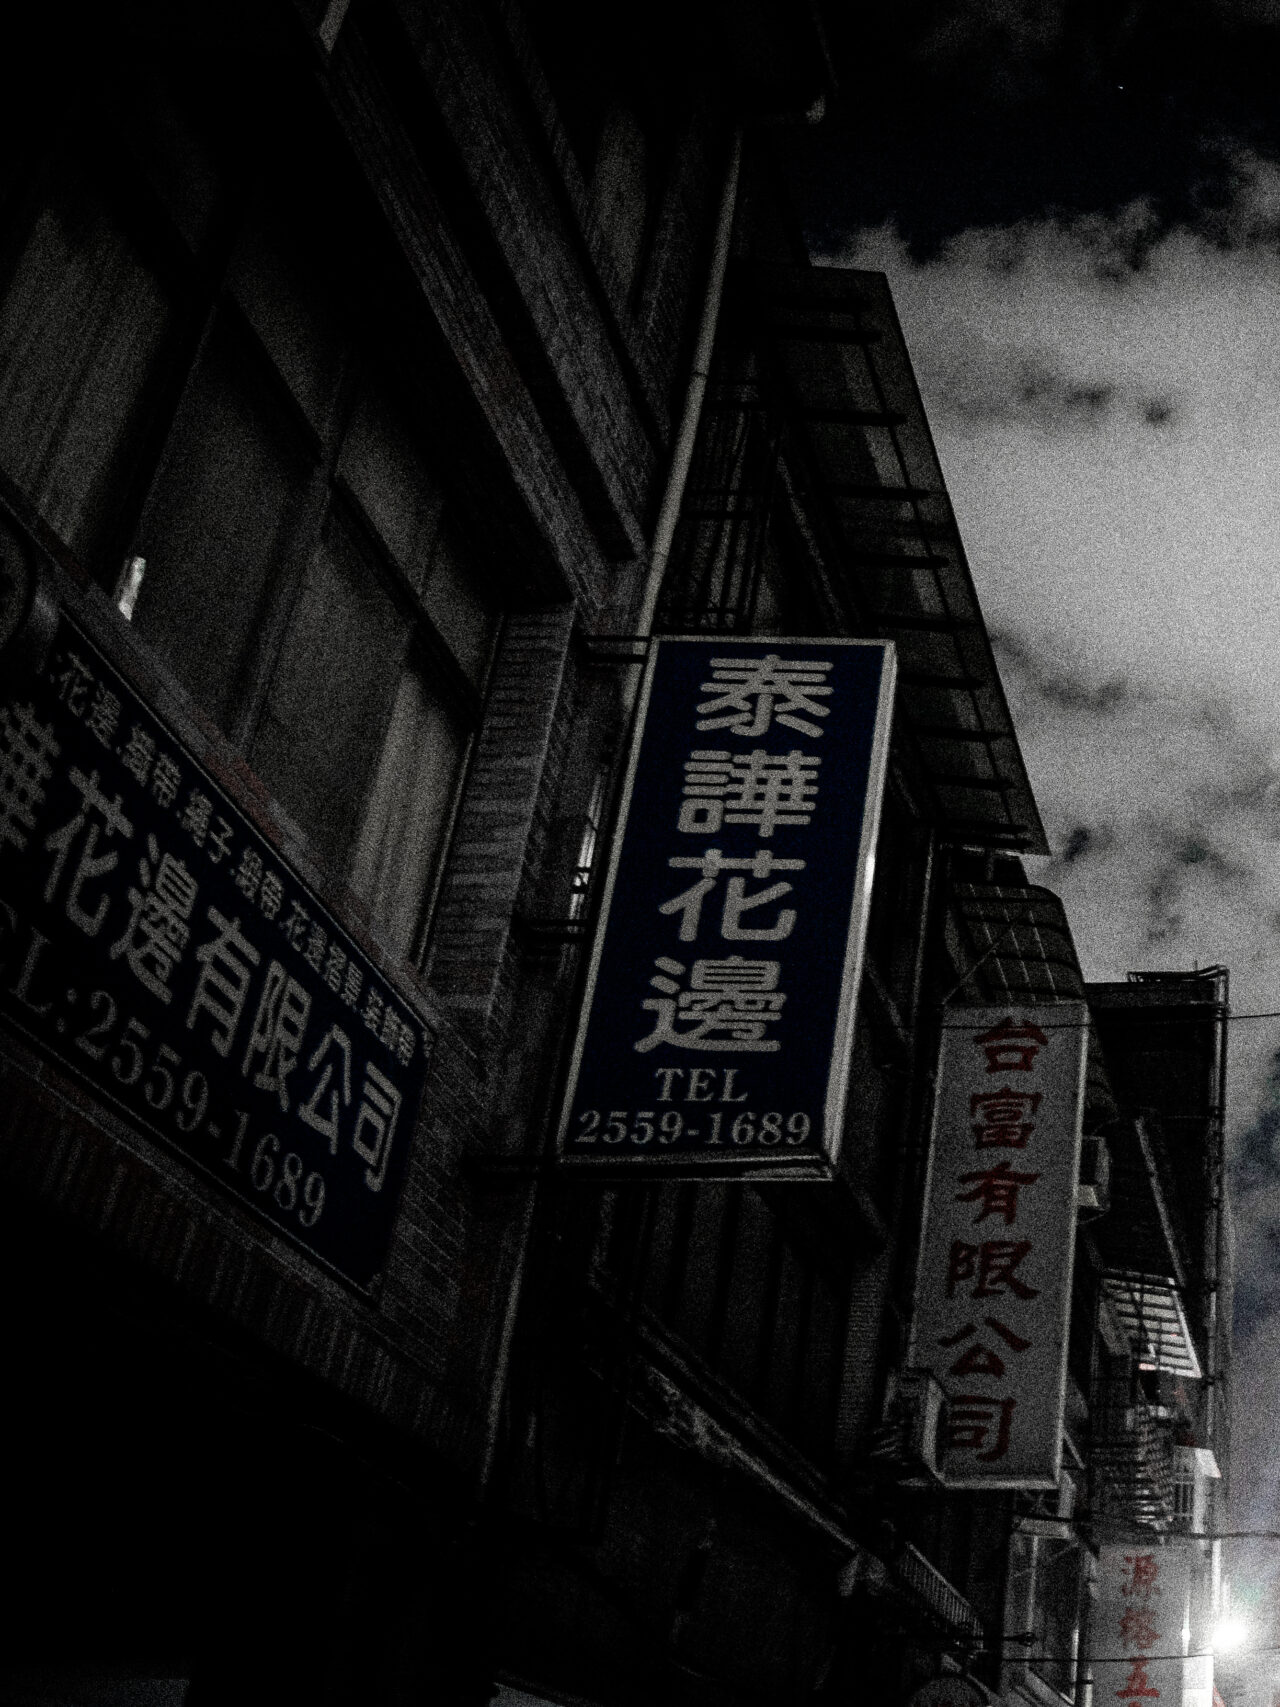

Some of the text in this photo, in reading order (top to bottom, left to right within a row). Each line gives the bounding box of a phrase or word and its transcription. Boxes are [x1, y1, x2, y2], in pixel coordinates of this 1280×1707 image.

[0, 897, 326, 1228] L:2559-1689
[574, 1109, 812, 1146] 2559-1689
[654, 1067, 750, 1103] TEL
[938, 1016, 1048, 1462] 台富有限公司
